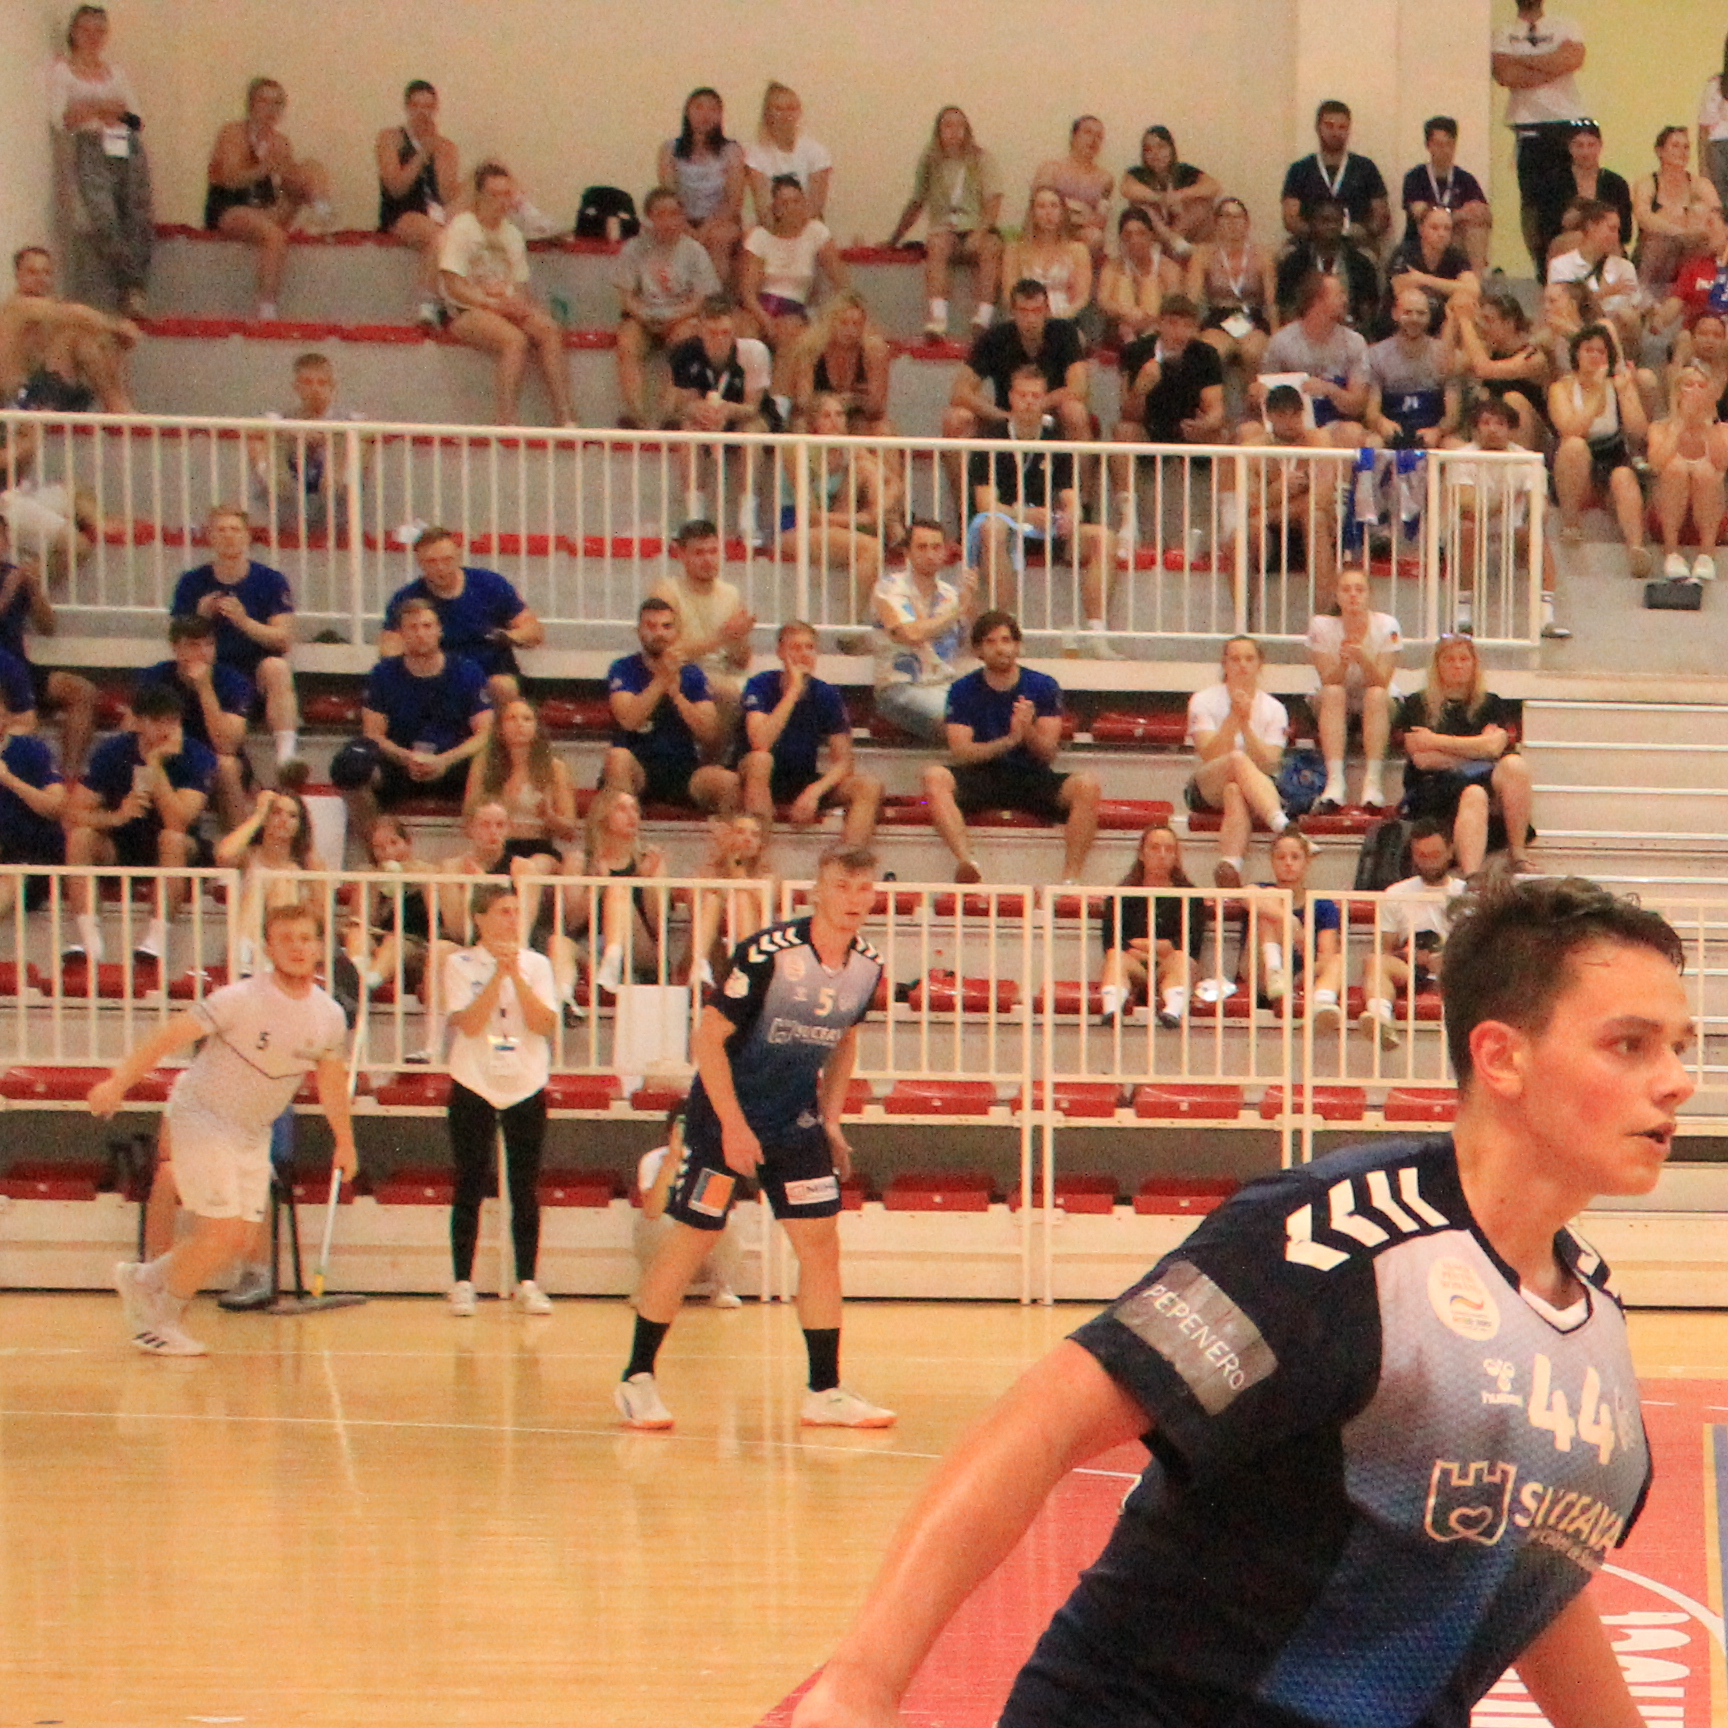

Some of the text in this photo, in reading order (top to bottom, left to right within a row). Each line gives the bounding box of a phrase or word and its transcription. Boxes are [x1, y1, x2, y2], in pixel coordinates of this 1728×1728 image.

[814, 987, 838, 1017] 5
[1141, 1281, 1247, 1395] PEPENERO
[1527, 1352, 1616, 1466] 44
